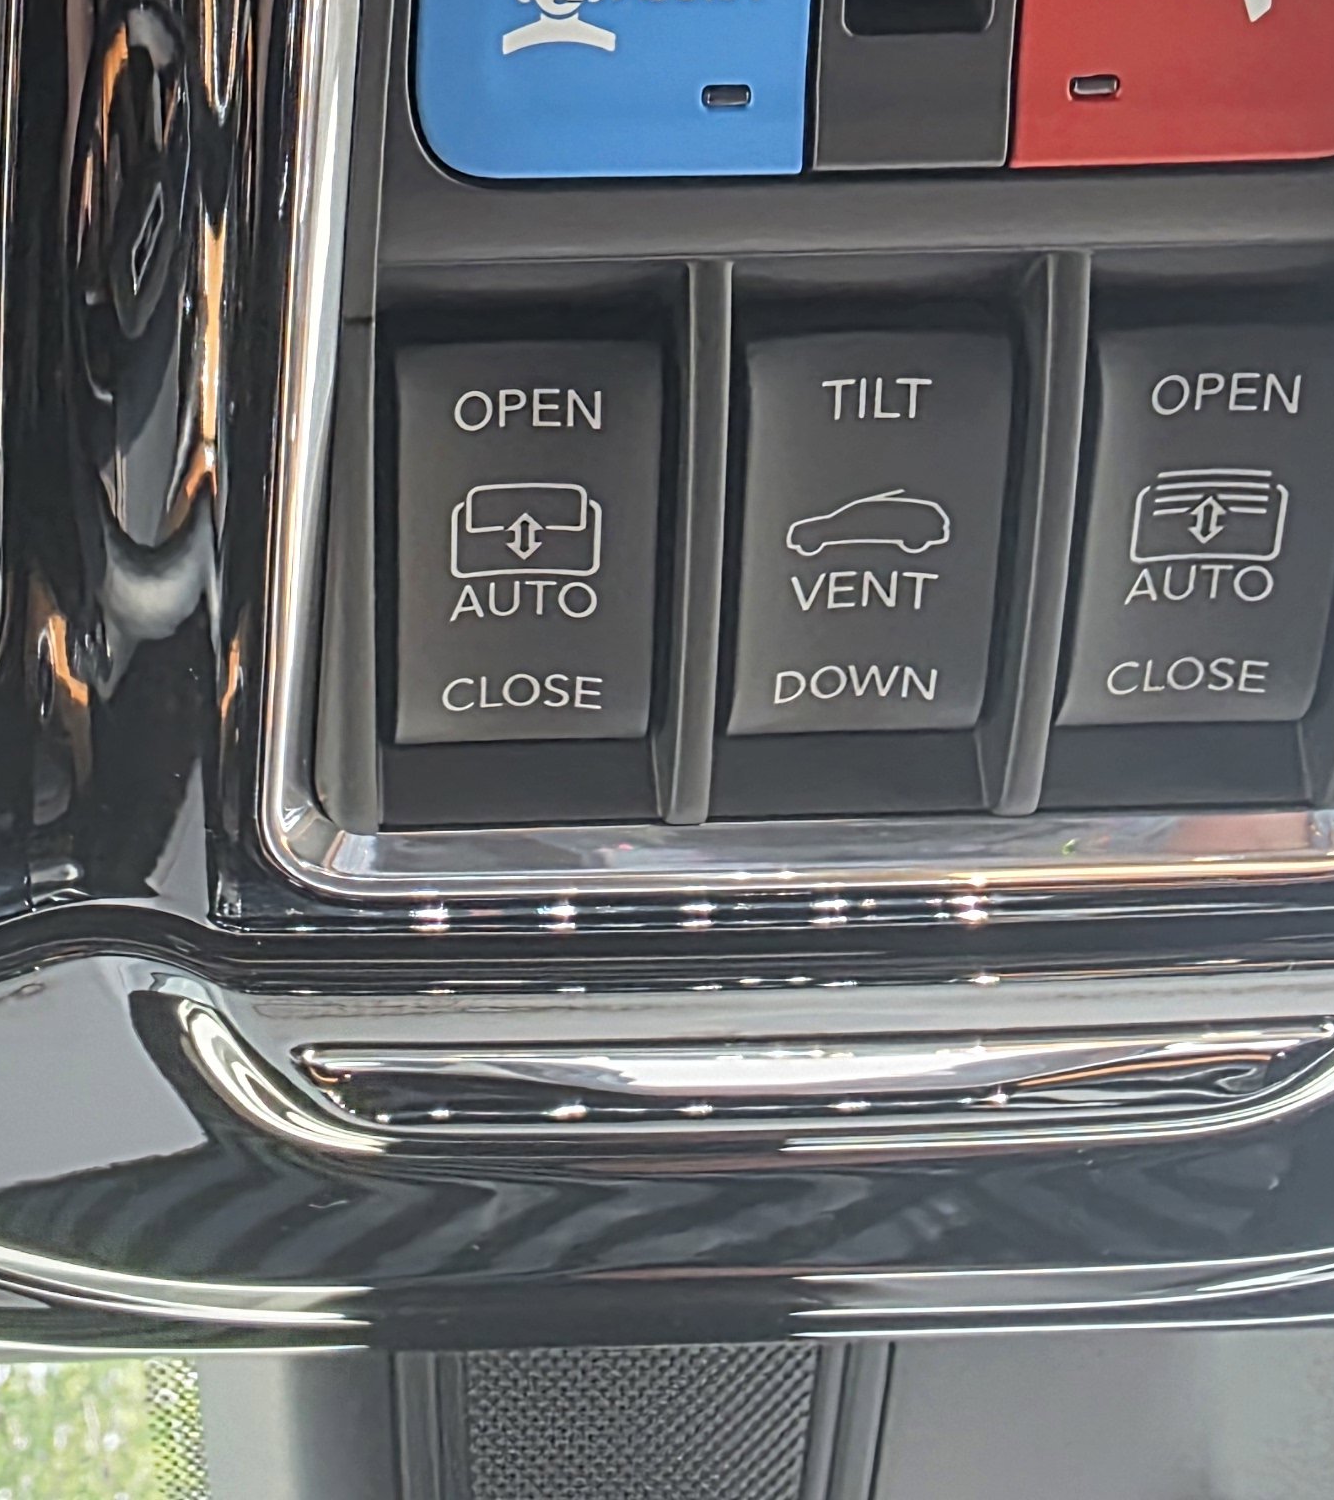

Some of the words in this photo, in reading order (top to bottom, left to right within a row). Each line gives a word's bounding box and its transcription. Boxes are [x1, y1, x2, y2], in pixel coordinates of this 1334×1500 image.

[453, 388, 602, 432] OPEN
[821, 377, 933, 421] TILT
[1151, 372, 1302, 416] OPEN
[449, 580, 598, 622] AUTO
[790, 570, 939, 611] VENT
[1123, 564, 1274, 606] AUTO
[441, 673, 603, 712] CLOSE
[773, 664, 938, 705] DOWN
[1106, 656, 1270, 696] CLOSE
